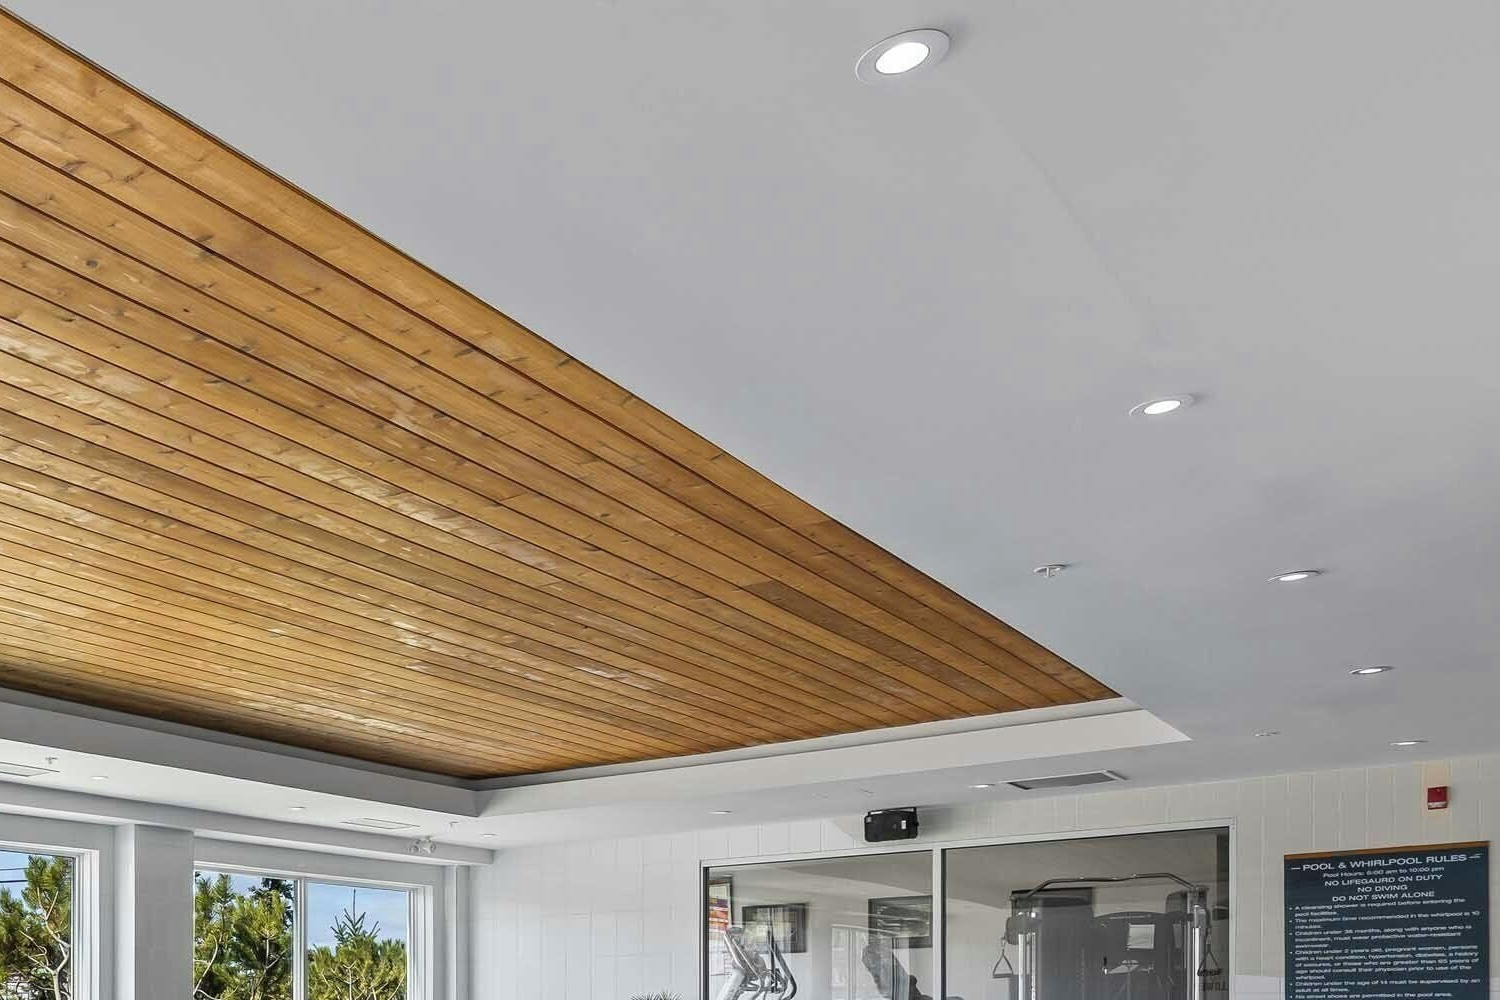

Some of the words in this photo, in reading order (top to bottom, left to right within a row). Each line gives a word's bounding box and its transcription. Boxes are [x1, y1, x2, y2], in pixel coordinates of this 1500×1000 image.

[1302, 862, 1335, 871] POOL
[1338, 861, 1347, 869] &
[1349, 856, 1422, 868] WHIRLPOOL
[1426, 854, 1467, 863] RULES
[1341, 876, 1395, 885] LIFEGAURD
[1374, 884, 1407, 892] DIVING
